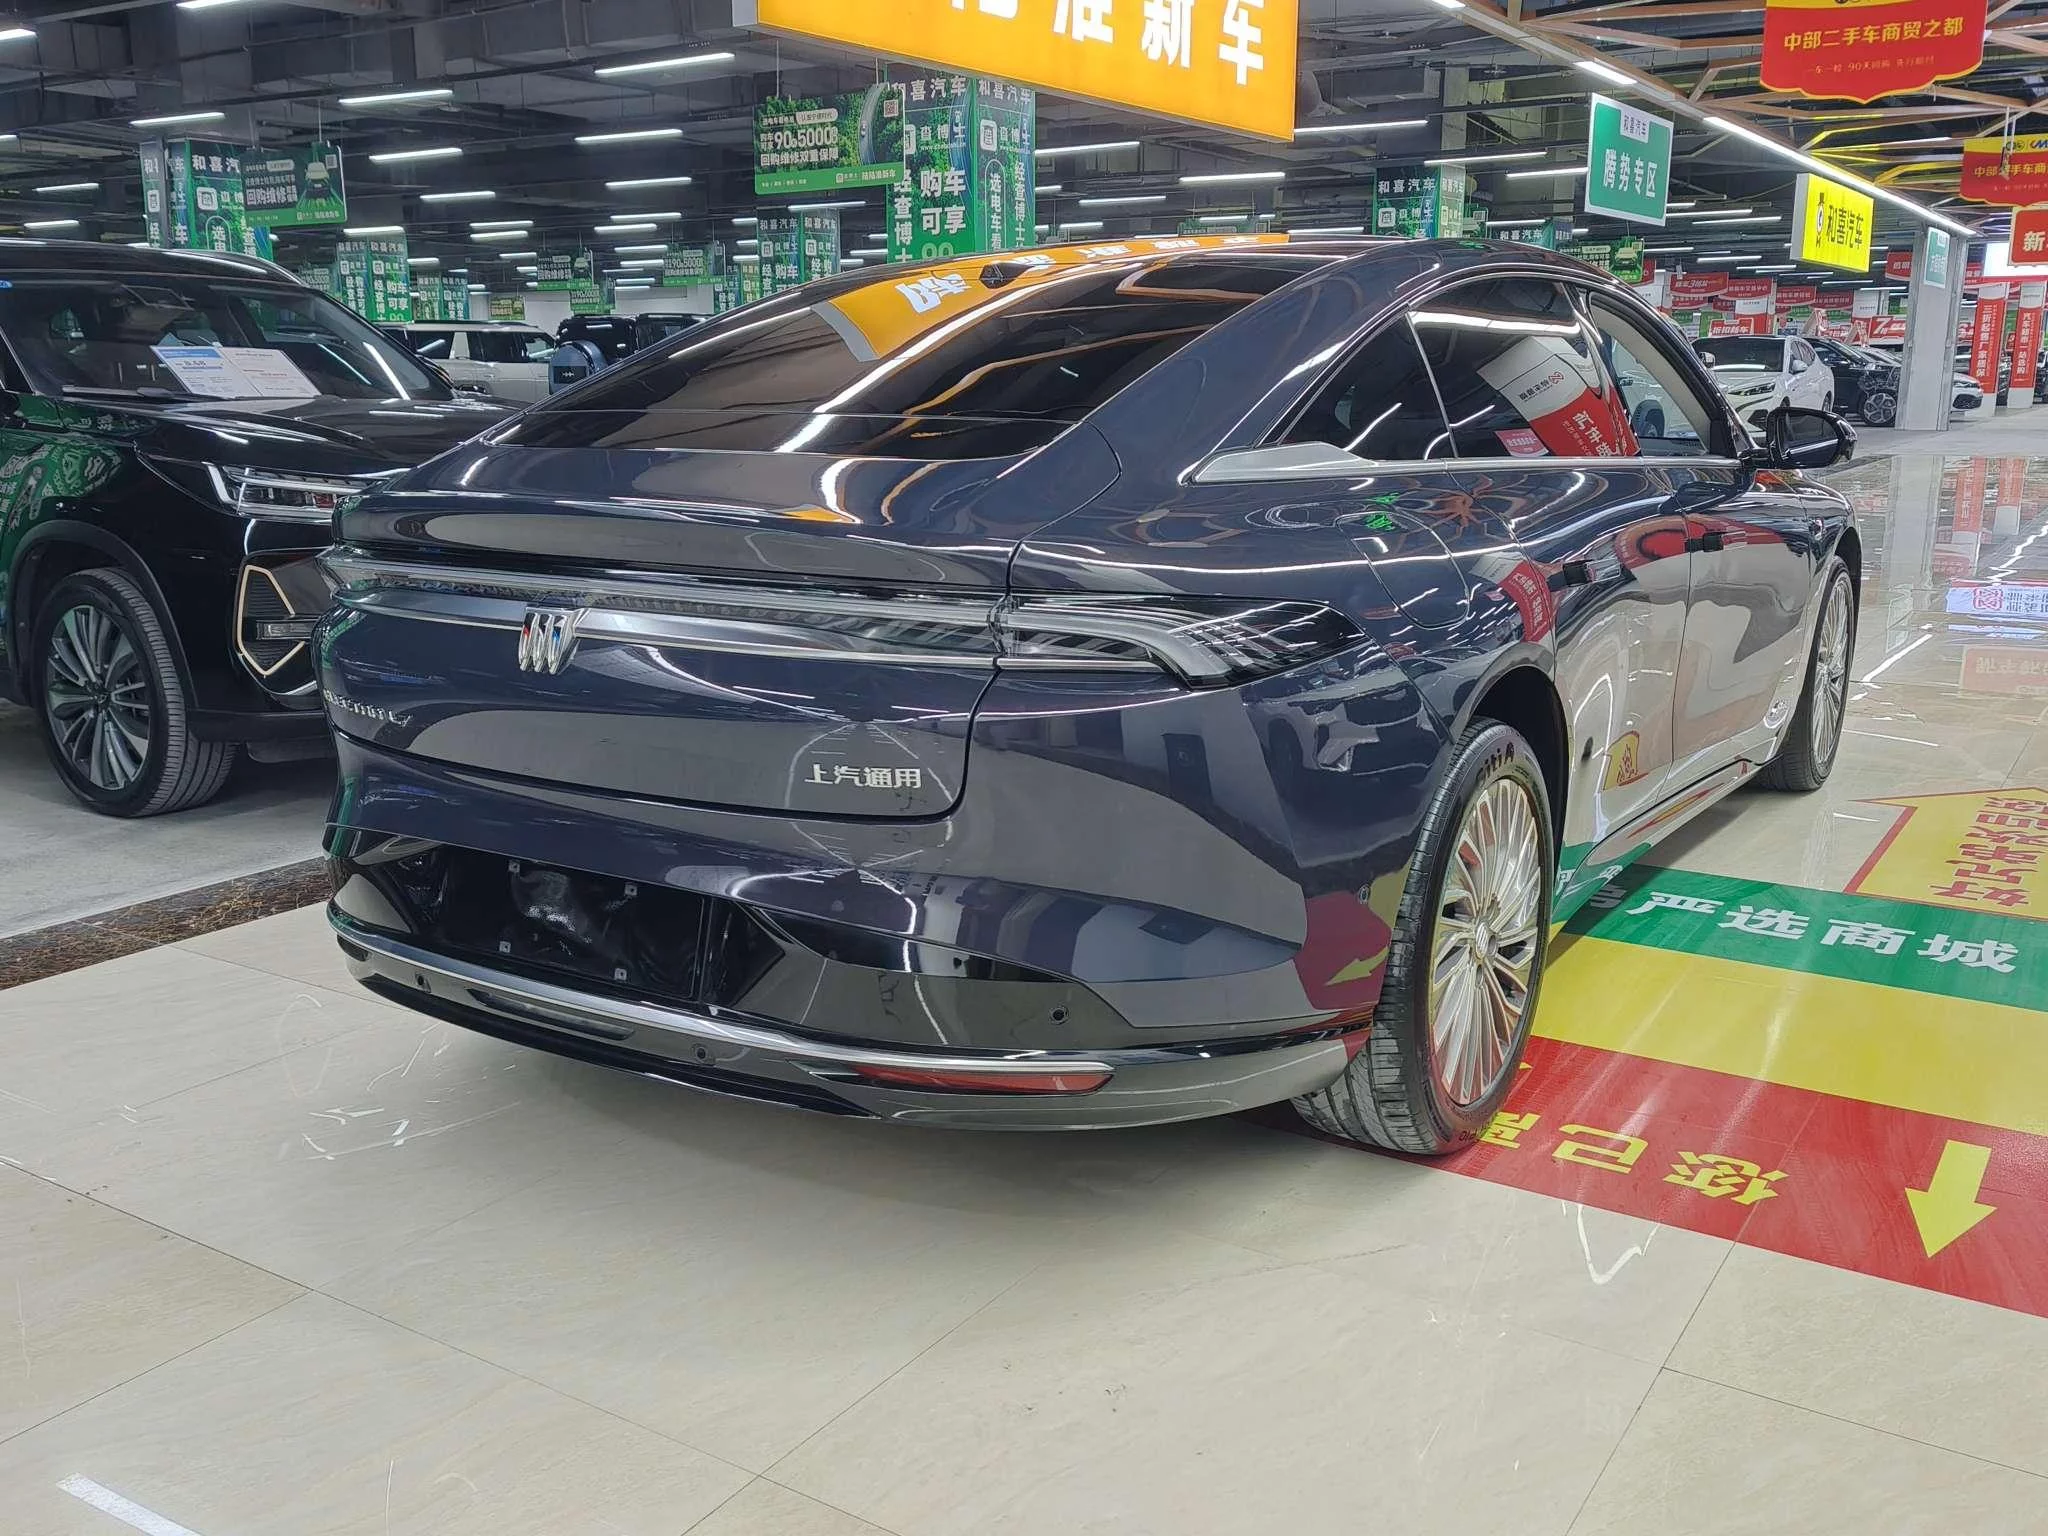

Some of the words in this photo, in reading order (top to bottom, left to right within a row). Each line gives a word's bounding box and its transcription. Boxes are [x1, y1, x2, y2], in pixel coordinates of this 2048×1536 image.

[1784, 16, 1964, 52] 中部二手车商贸之都
[979, 79, 1032, 105] 和喜汽车
[1623, 113, 1647, 136] 和喜汽车
[760, 147, 839, 167] 回购维修双重保障
[920, 169, 966, 198] 购车
[1603, 148, 1658, 198] 腾势专区
[1378, 177, 1436, 194] 和喜汽车
[759, 217, 798, 230] 和喜汽车
[920, 204, 966, 236] 可享
[1826, 204, 1864, 249] 和喜汽车
[1500, 229, 1543, 241] 和喜汽车
[2023, 230, 2045, 252] 新
[775, 264, 798, 279] 购车
[804, 763, 922, 789] 上汽通用
